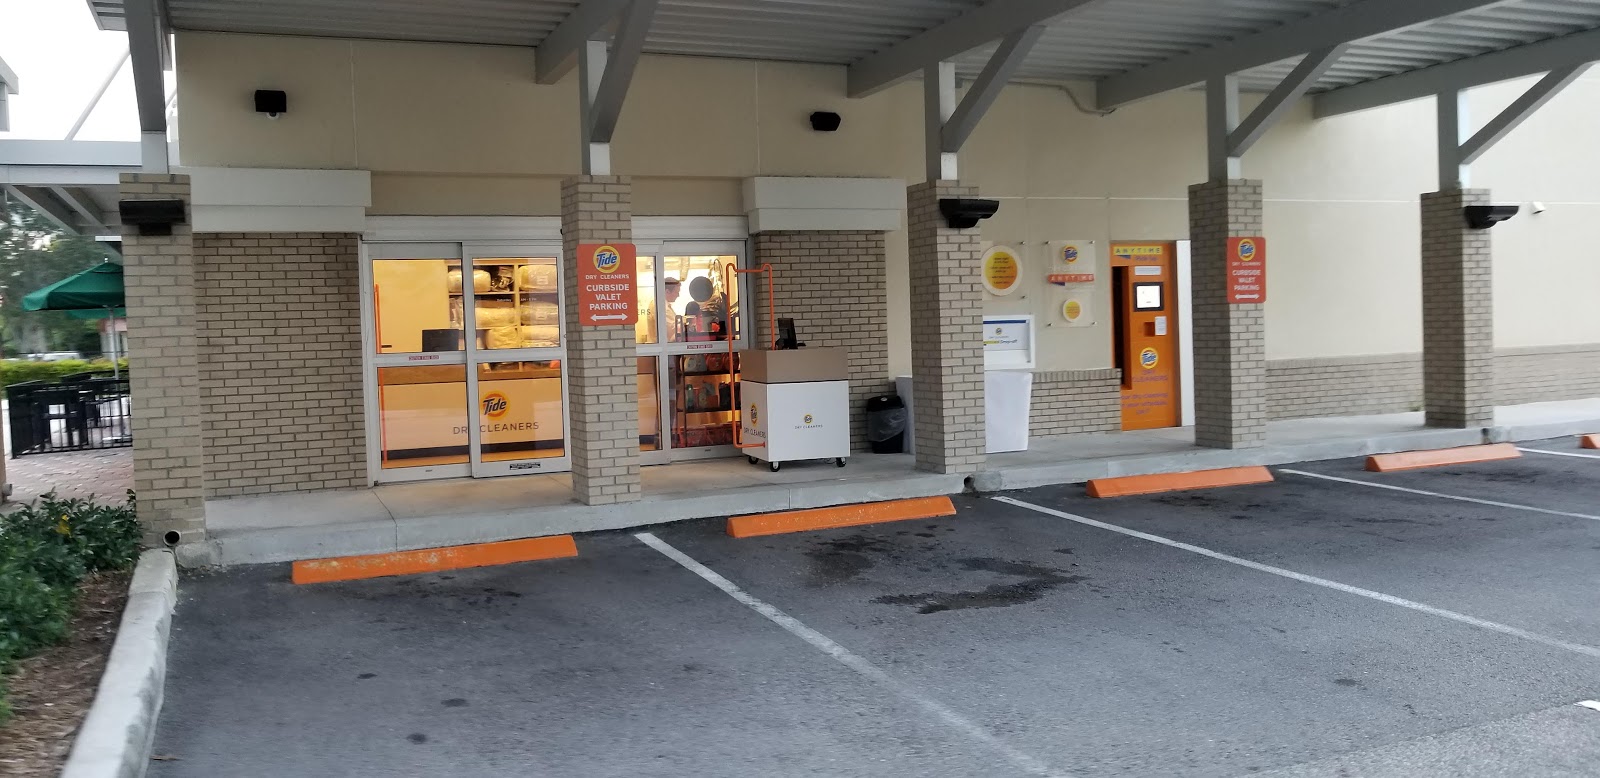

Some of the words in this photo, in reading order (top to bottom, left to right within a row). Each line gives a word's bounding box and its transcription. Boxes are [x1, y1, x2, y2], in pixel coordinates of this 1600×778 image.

[596, 252, 618, 268] Tide
[589, 302, 628, 310] PARKING
[482, 398, 507, 415] Tide
[453, 426, 468, 435] DR
[480, 421, 539, 433] CLEANERS
